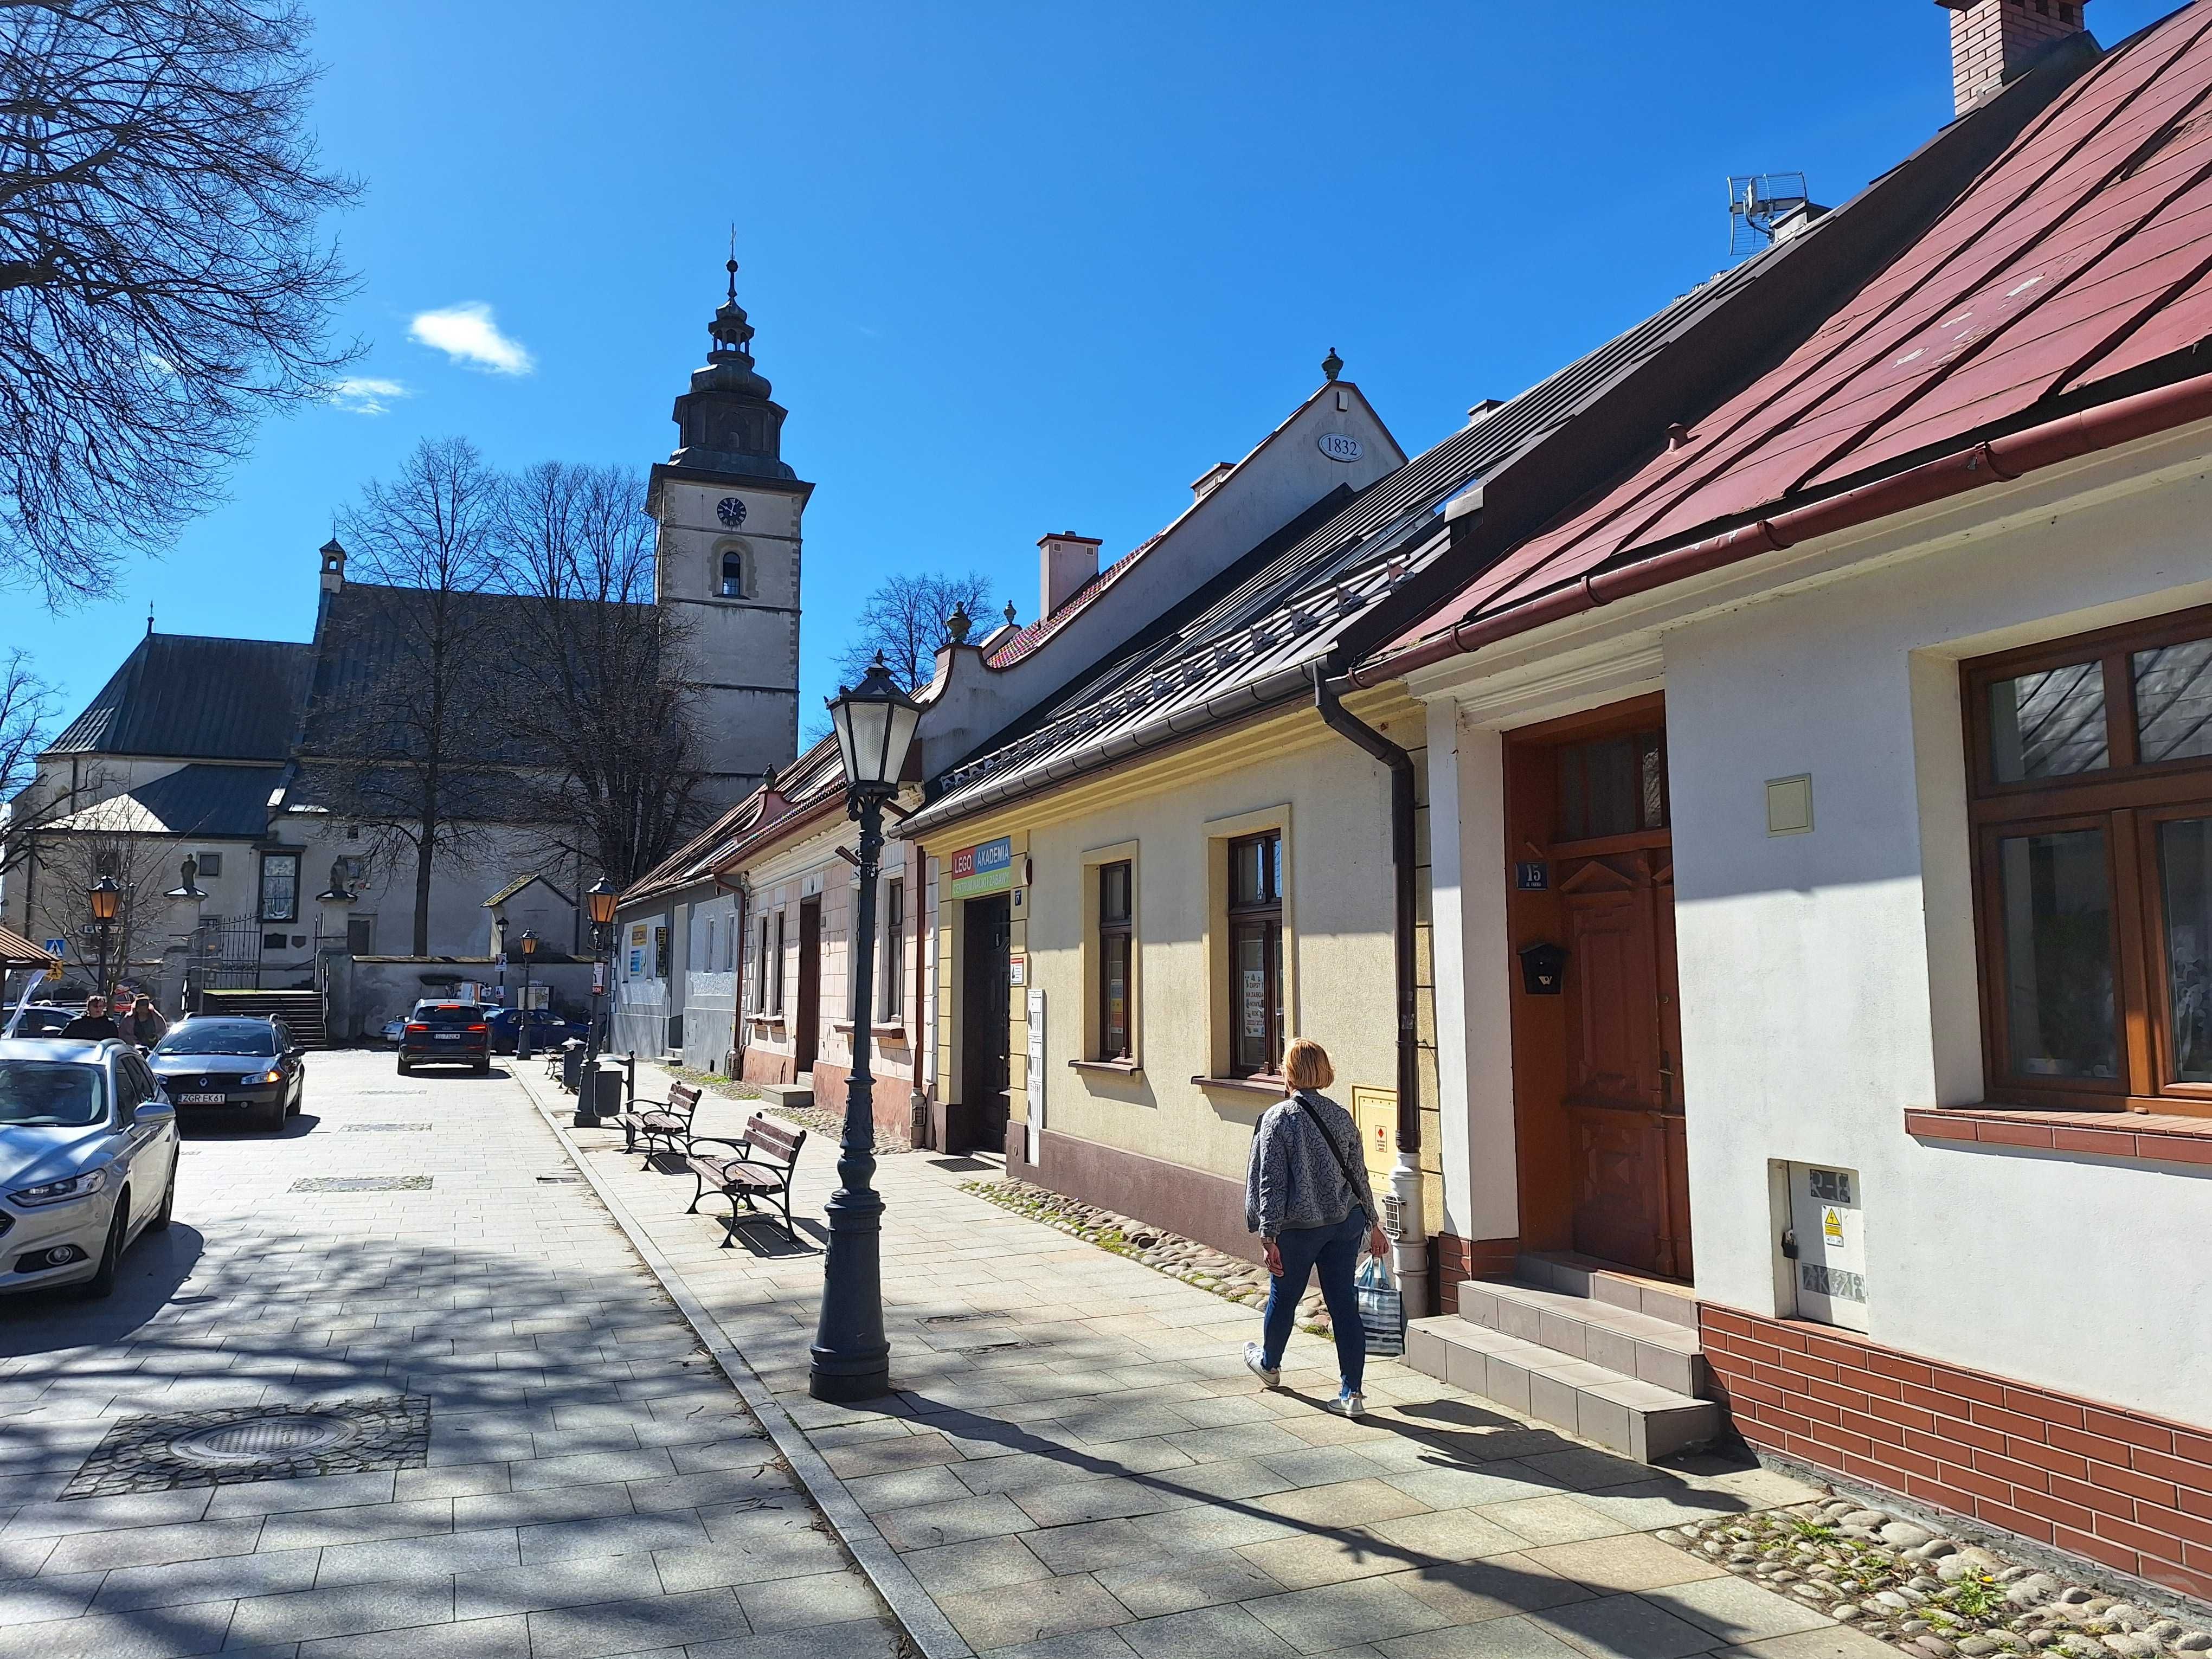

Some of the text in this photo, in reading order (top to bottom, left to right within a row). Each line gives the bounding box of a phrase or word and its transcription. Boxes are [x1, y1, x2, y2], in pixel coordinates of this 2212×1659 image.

[1328, 438, 1357, 455] 1832
[954, 844, 1009, 874] LEGO AKADEMIA
[1527, 864, 1541, 881] 15
[954, 879, 973, 894] CENTRUM
[989, 872, 1009, 886] ZABAWY
